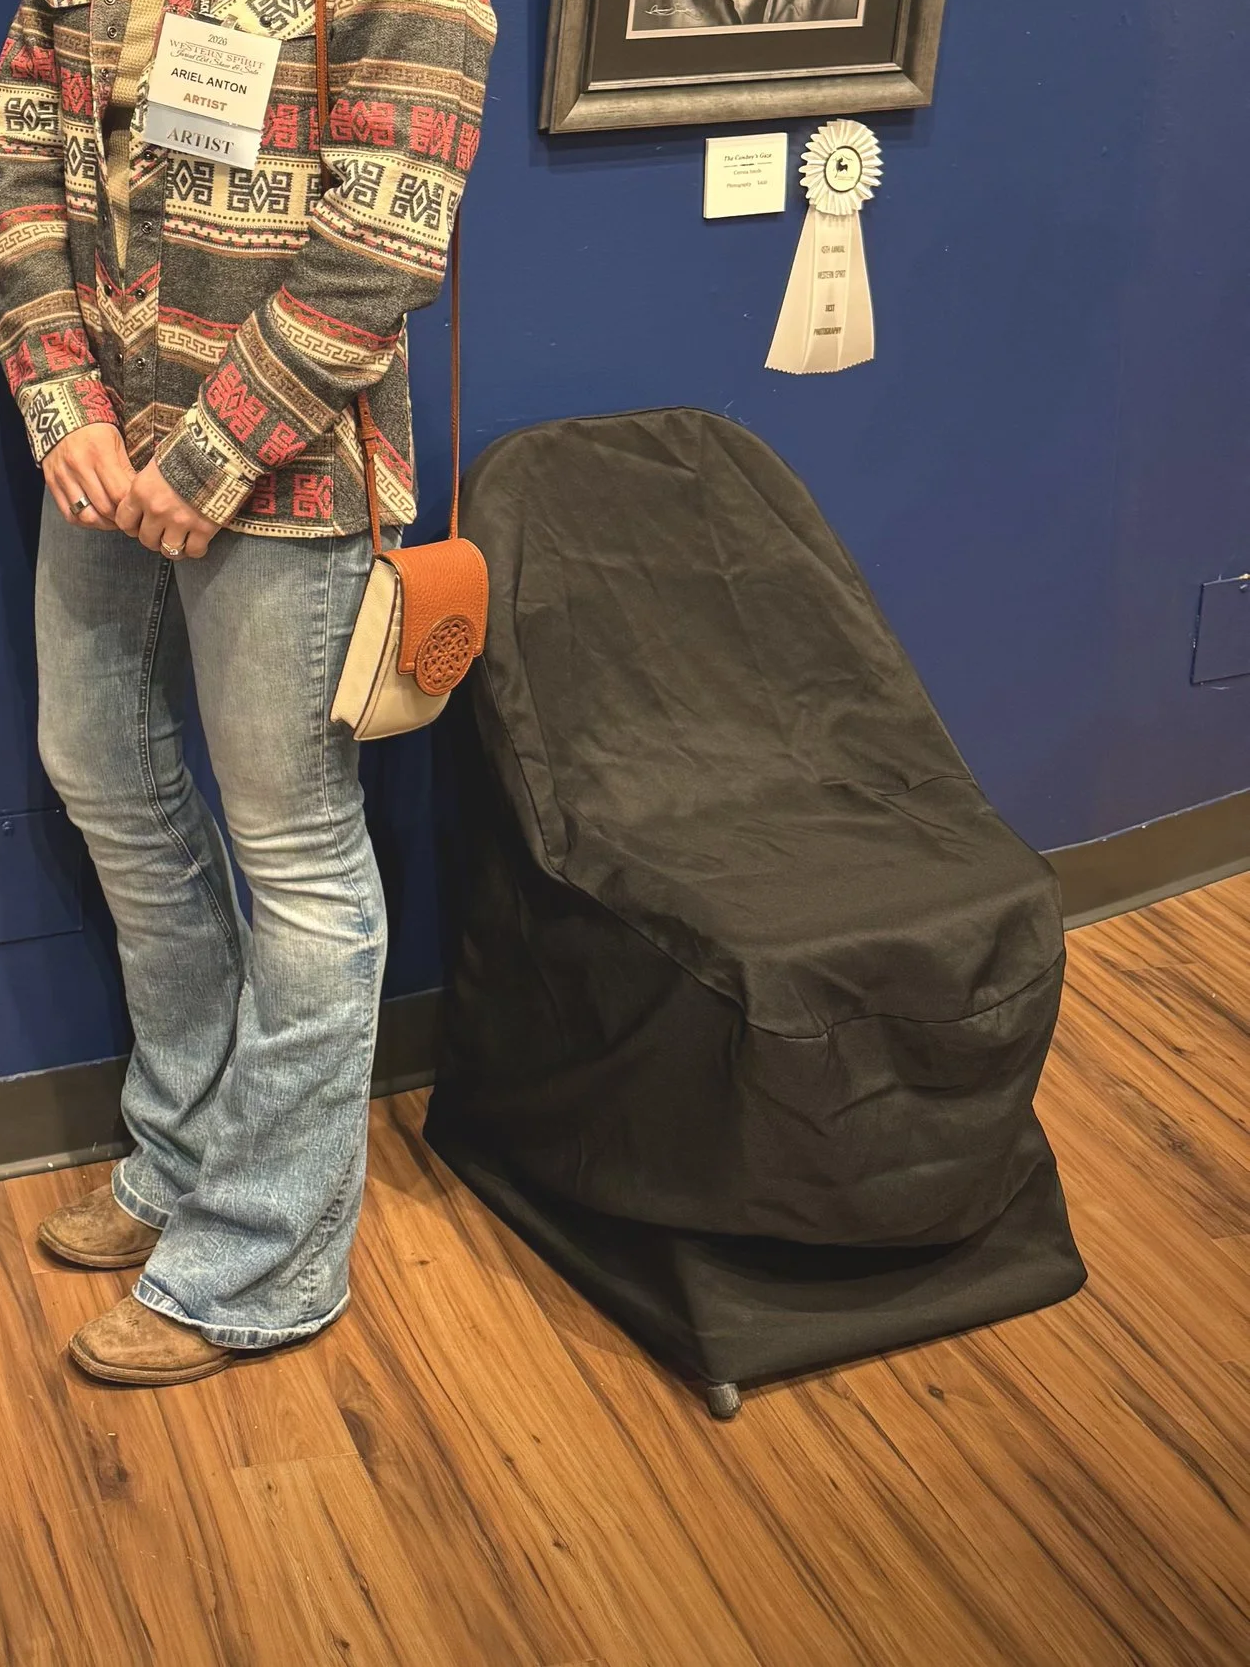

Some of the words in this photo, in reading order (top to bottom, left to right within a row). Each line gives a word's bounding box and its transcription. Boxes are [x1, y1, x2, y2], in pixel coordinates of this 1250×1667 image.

[169, 39, 223, 60] WESTERN
[226, 54, 265, 69] SPIRIT
[171, 67, 203, 84] ARIEL
[206, 77, 247, 95] ANTON
[183, 92, 227, 111] ARTIST
[167, 127, 234, 155] ARTIST
